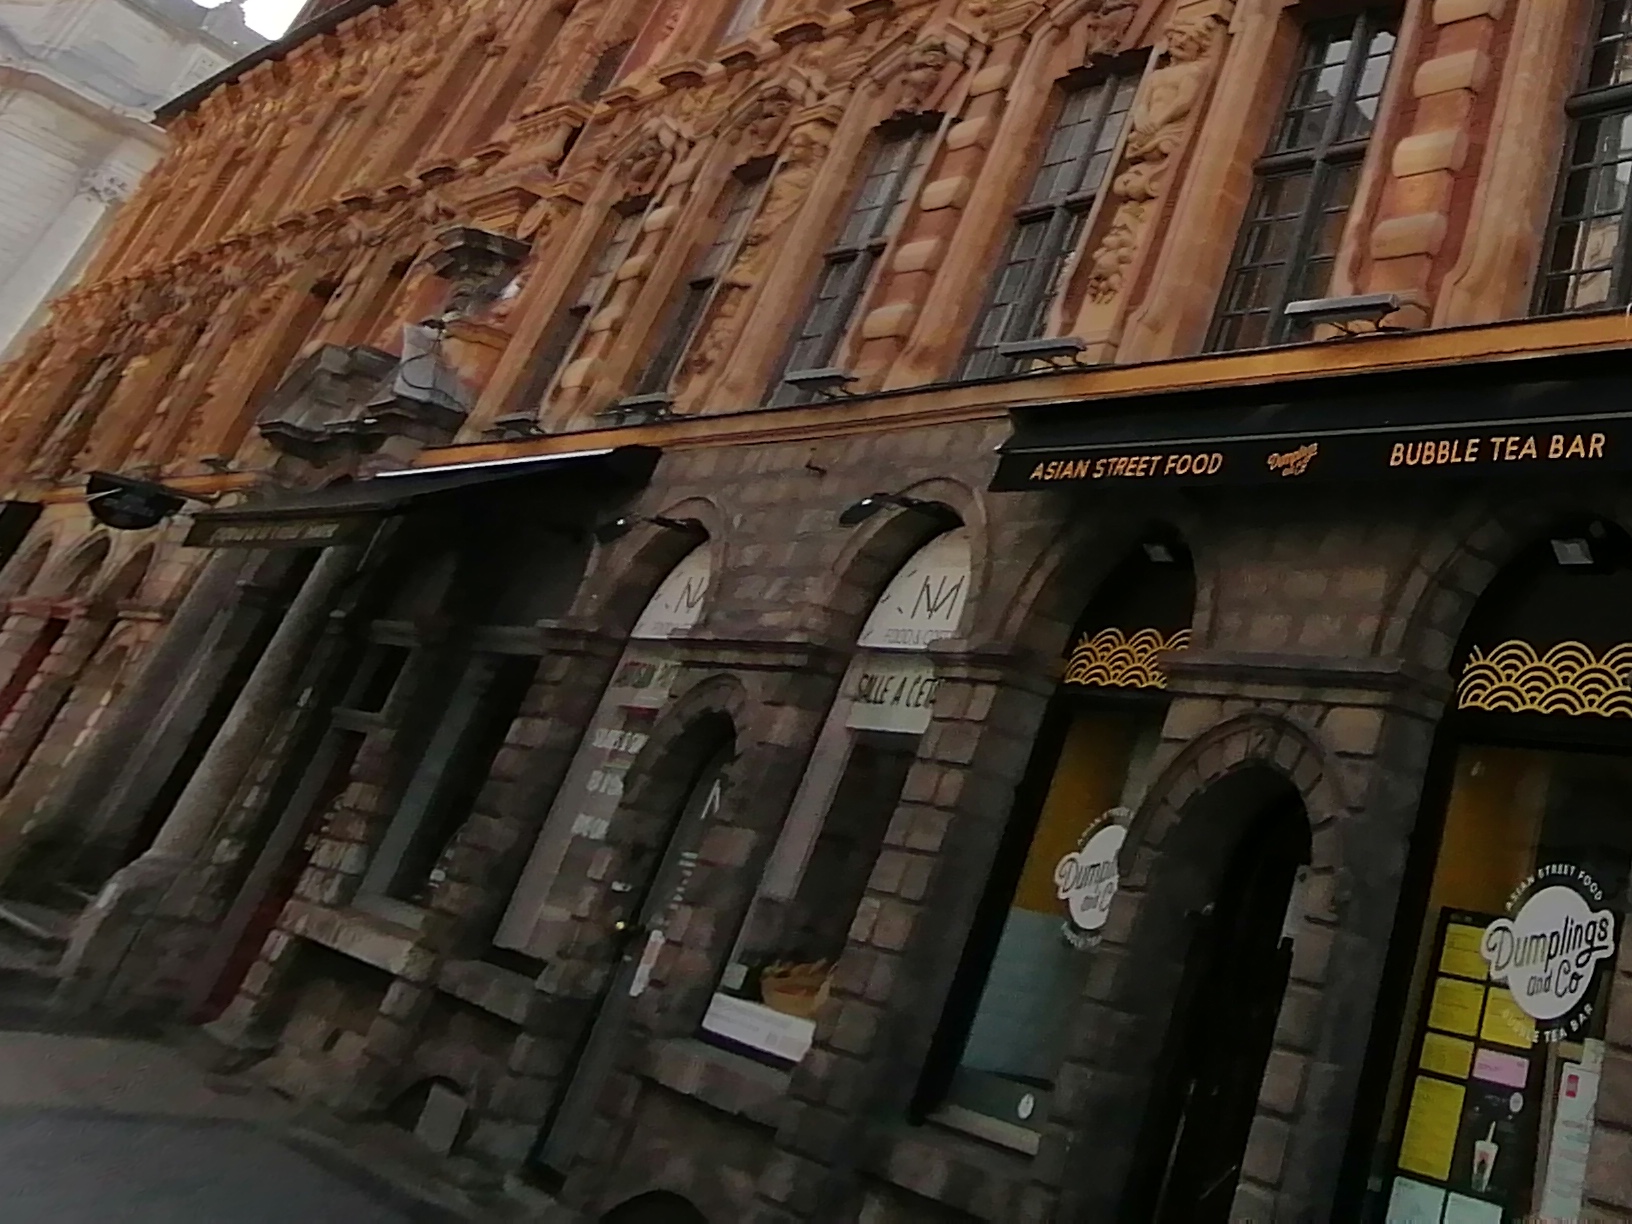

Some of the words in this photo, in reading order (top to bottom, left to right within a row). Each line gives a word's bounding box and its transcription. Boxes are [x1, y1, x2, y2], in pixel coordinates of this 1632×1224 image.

[1029, 459, 1091, 481] ASIAN
[1092, 456, 1163, 478] STREET
[1164, 453, 1223, 476] FOOD
[1388, 438, 1480, 467] BUBBLE
[1489, 436, 1537, 461] TEA
[1547, 433, 1606, 460] BAR
[1486, 914, 1610, 973] Dumplings
[1526, 968, 1554, 998] and
[1554, 959, 1585, 998] Co
[1543, 1027, 1568, 1044] TEA
[1569, 1003, 1595, 1033] BAR
